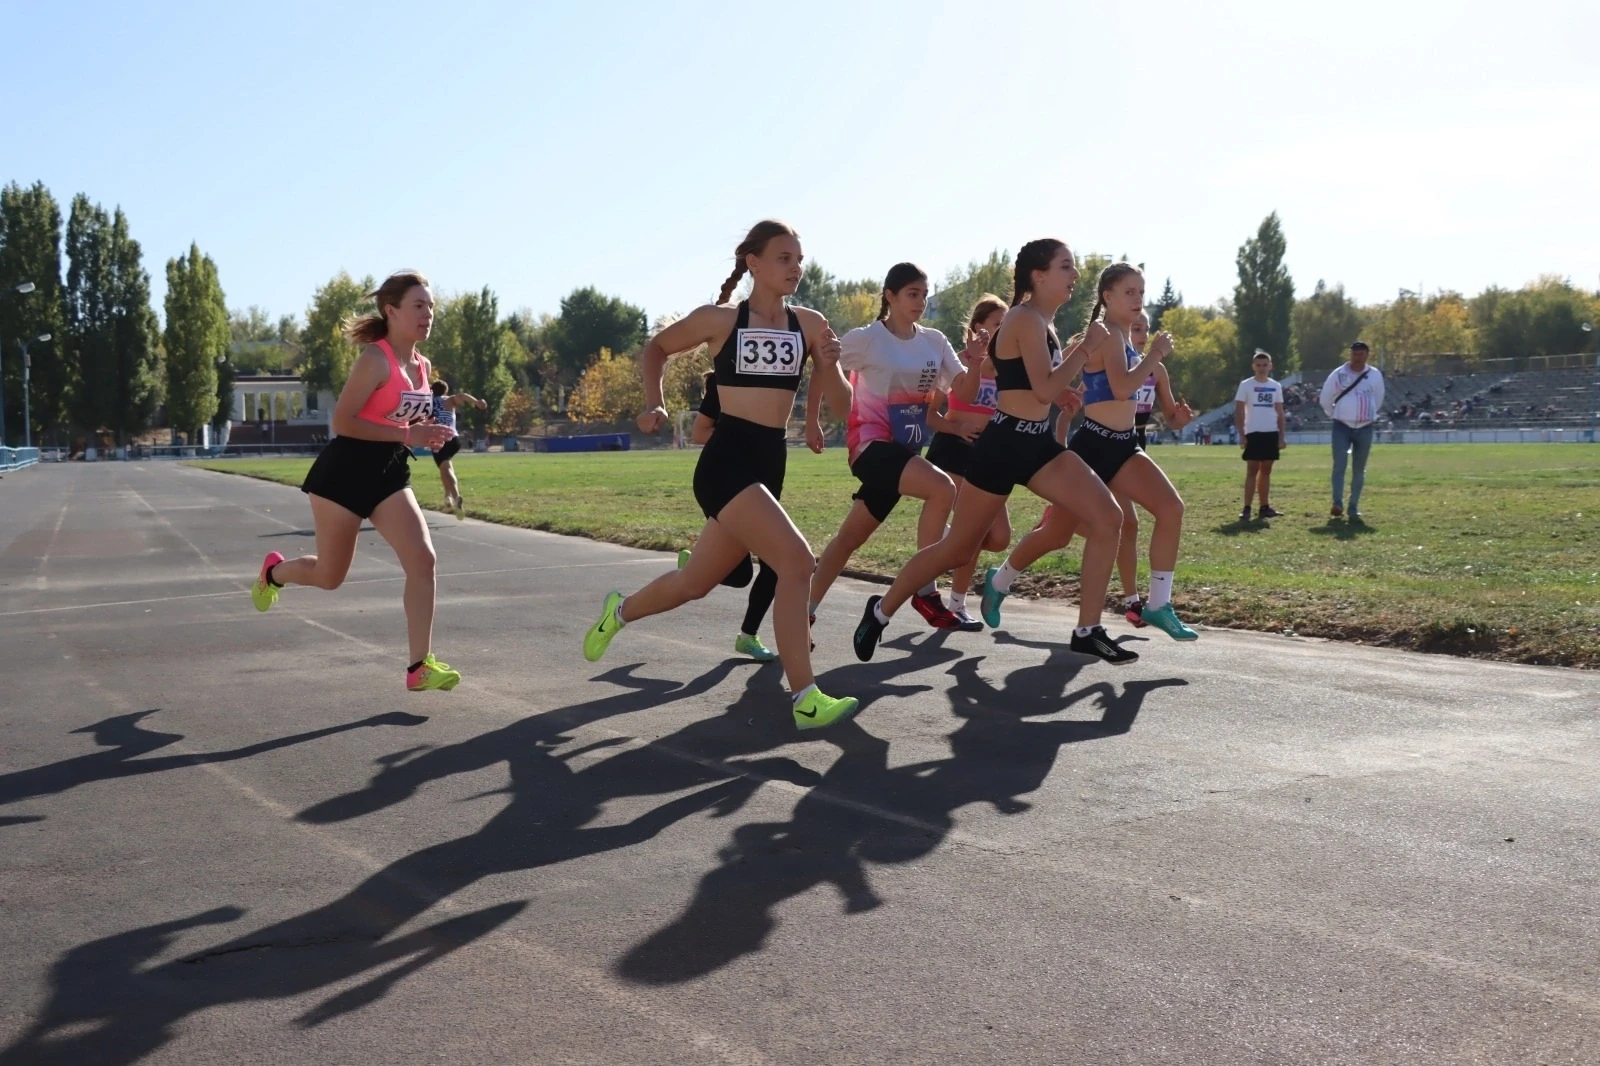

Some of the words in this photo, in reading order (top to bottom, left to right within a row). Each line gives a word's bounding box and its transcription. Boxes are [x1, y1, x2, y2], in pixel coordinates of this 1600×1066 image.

[743, 340, 795, 365] 333
[1257, 392, 1273, 403] 648
[395, 401, 431, 418] 315
[904, 423, 922, 444] 70
[1083, 420, 1111, 437] NIKE
[1109, 432, 1131, 441] PRO
